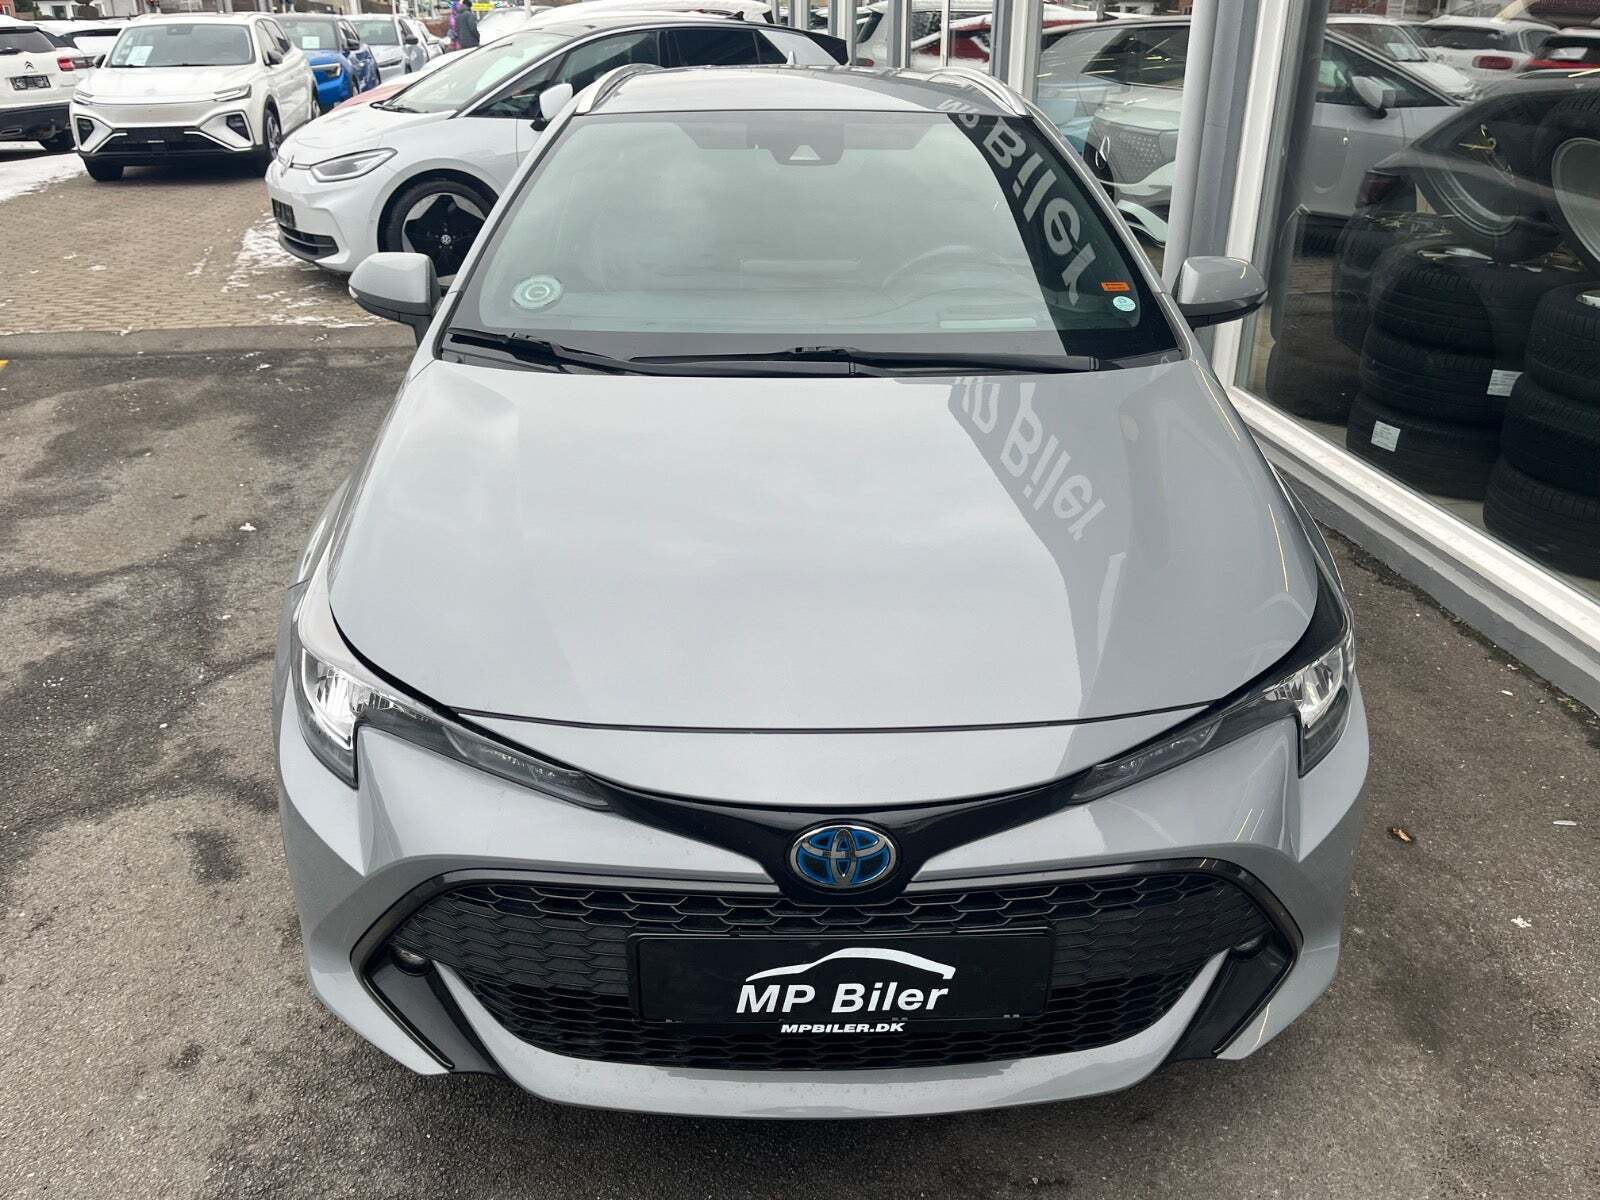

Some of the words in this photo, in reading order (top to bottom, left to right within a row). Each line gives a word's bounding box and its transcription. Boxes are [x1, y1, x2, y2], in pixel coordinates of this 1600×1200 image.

[736, 984, 816, 1014] MP
[831, 981, 949, 1013] Biler
[780, 1022, 906, 1033] MPBILER.DK
